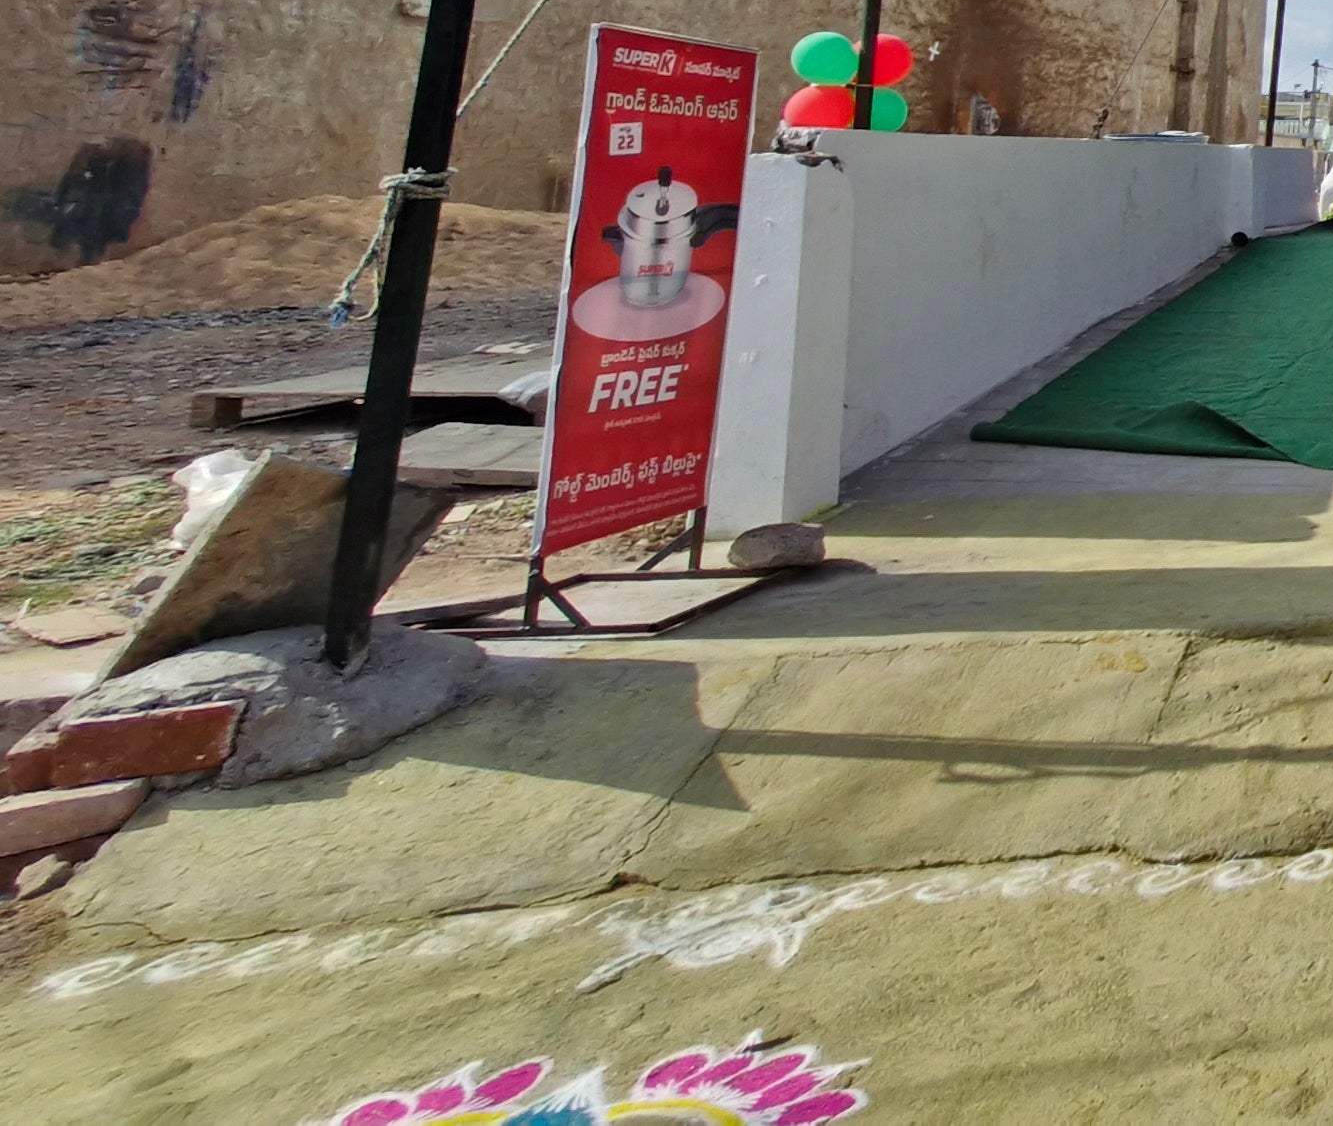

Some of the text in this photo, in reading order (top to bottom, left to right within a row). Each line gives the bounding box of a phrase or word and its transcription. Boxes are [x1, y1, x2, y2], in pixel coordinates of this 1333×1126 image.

[605, 88, 647, 114] గ్రాండ్
[649, 93, 705, 117] ఓపెనింగ్
[617, 135, 635, 150] 22
